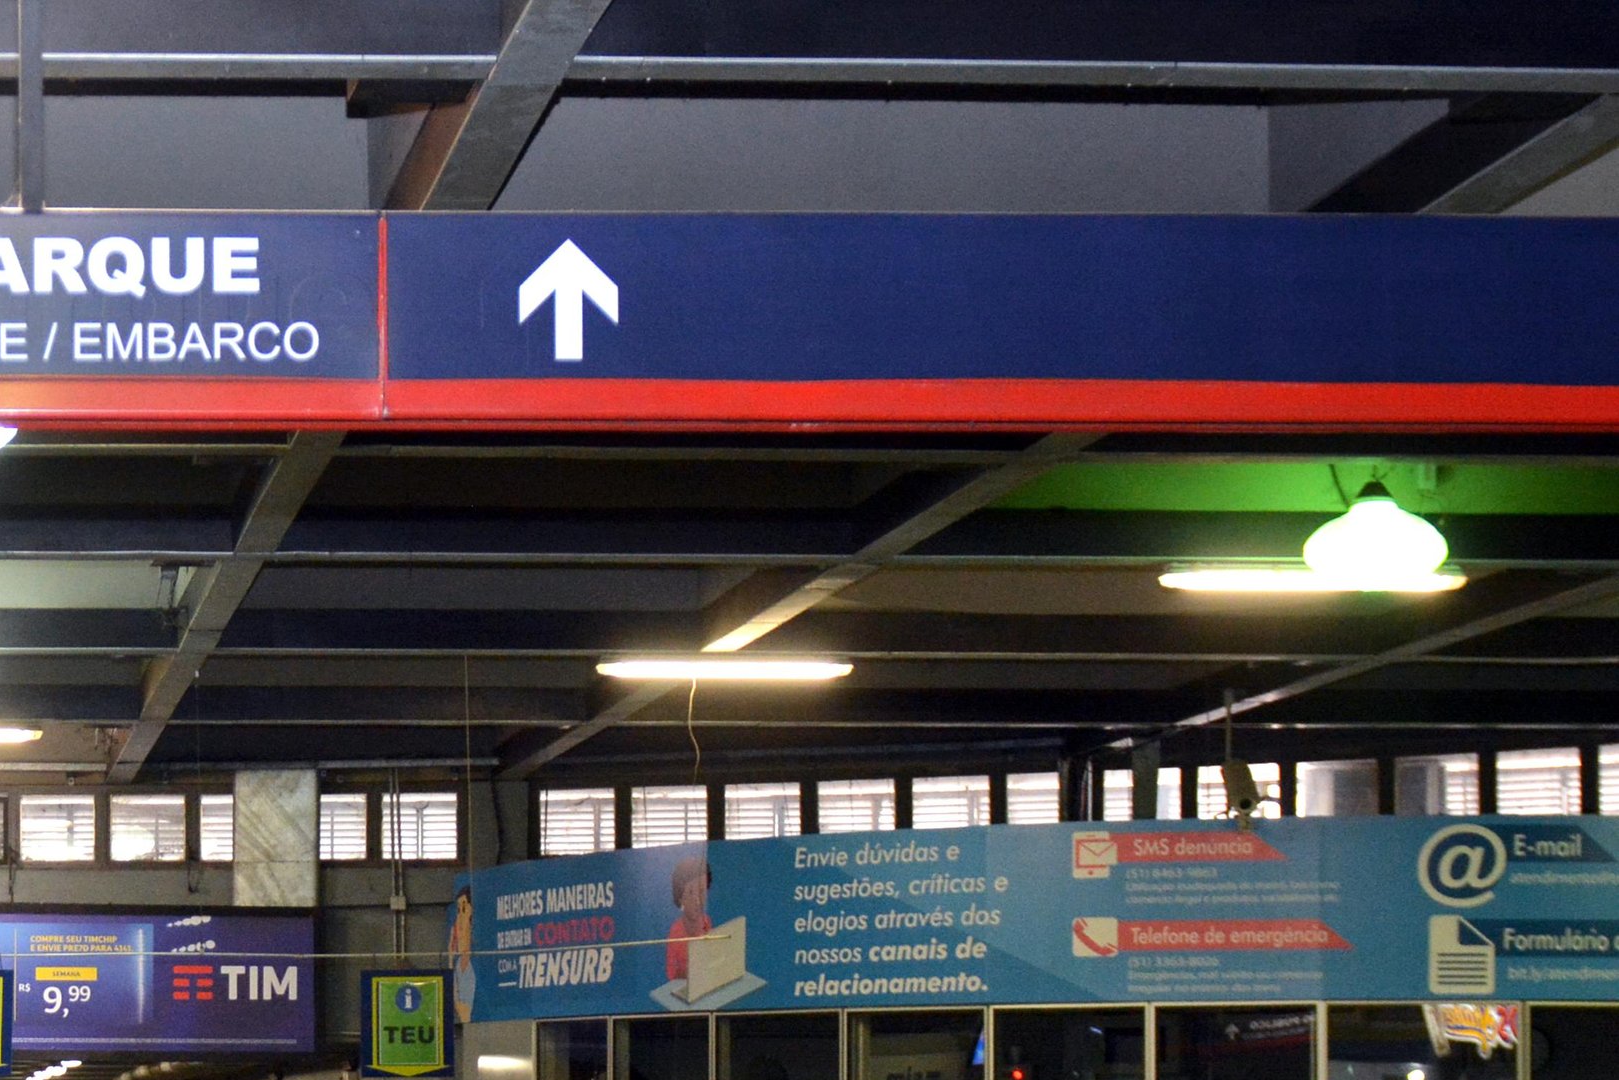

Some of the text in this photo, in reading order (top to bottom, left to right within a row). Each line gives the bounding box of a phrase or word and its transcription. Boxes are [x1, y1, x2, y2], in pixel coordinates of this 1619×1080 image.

[42, 322, 58, 360] /
[72, 321, 320, 361] EMBARCO
[794, 840, 960, 868] Envie dúvidas e
[1133, 836, 1254, 856] SMS denúncia
[1513, 834, 1582, 856] E-mail
[497, 881, 614, 920] MELHORES MANEIRAS
[794, 873, 1009, 905] sugestões, críticas e
[534, 915, 615, 946] CONTATO
[794, 902, 1001, 937] elogios através dos
[30, 935, 63, 943] COMPRE
[66, 935, 81, 943] SEU
[37, 944, 61, 952] ENVIE
[90, 944, 112, 952] PARA
[1131, 925, 1329, 947] Telefone de emergência
[1502, 928, 1610, 951] Formulário
[794, 936, 988, 965] nossos canais de
[519, 947, 615, 989] TRENSURB
[220, 965, 298, 1000] TIM
[794, 971, 989, 997] relacionamento.
[18, 984, 91, 1017] R$ 9,99
[383, 1026, 434, 1044] TEU
